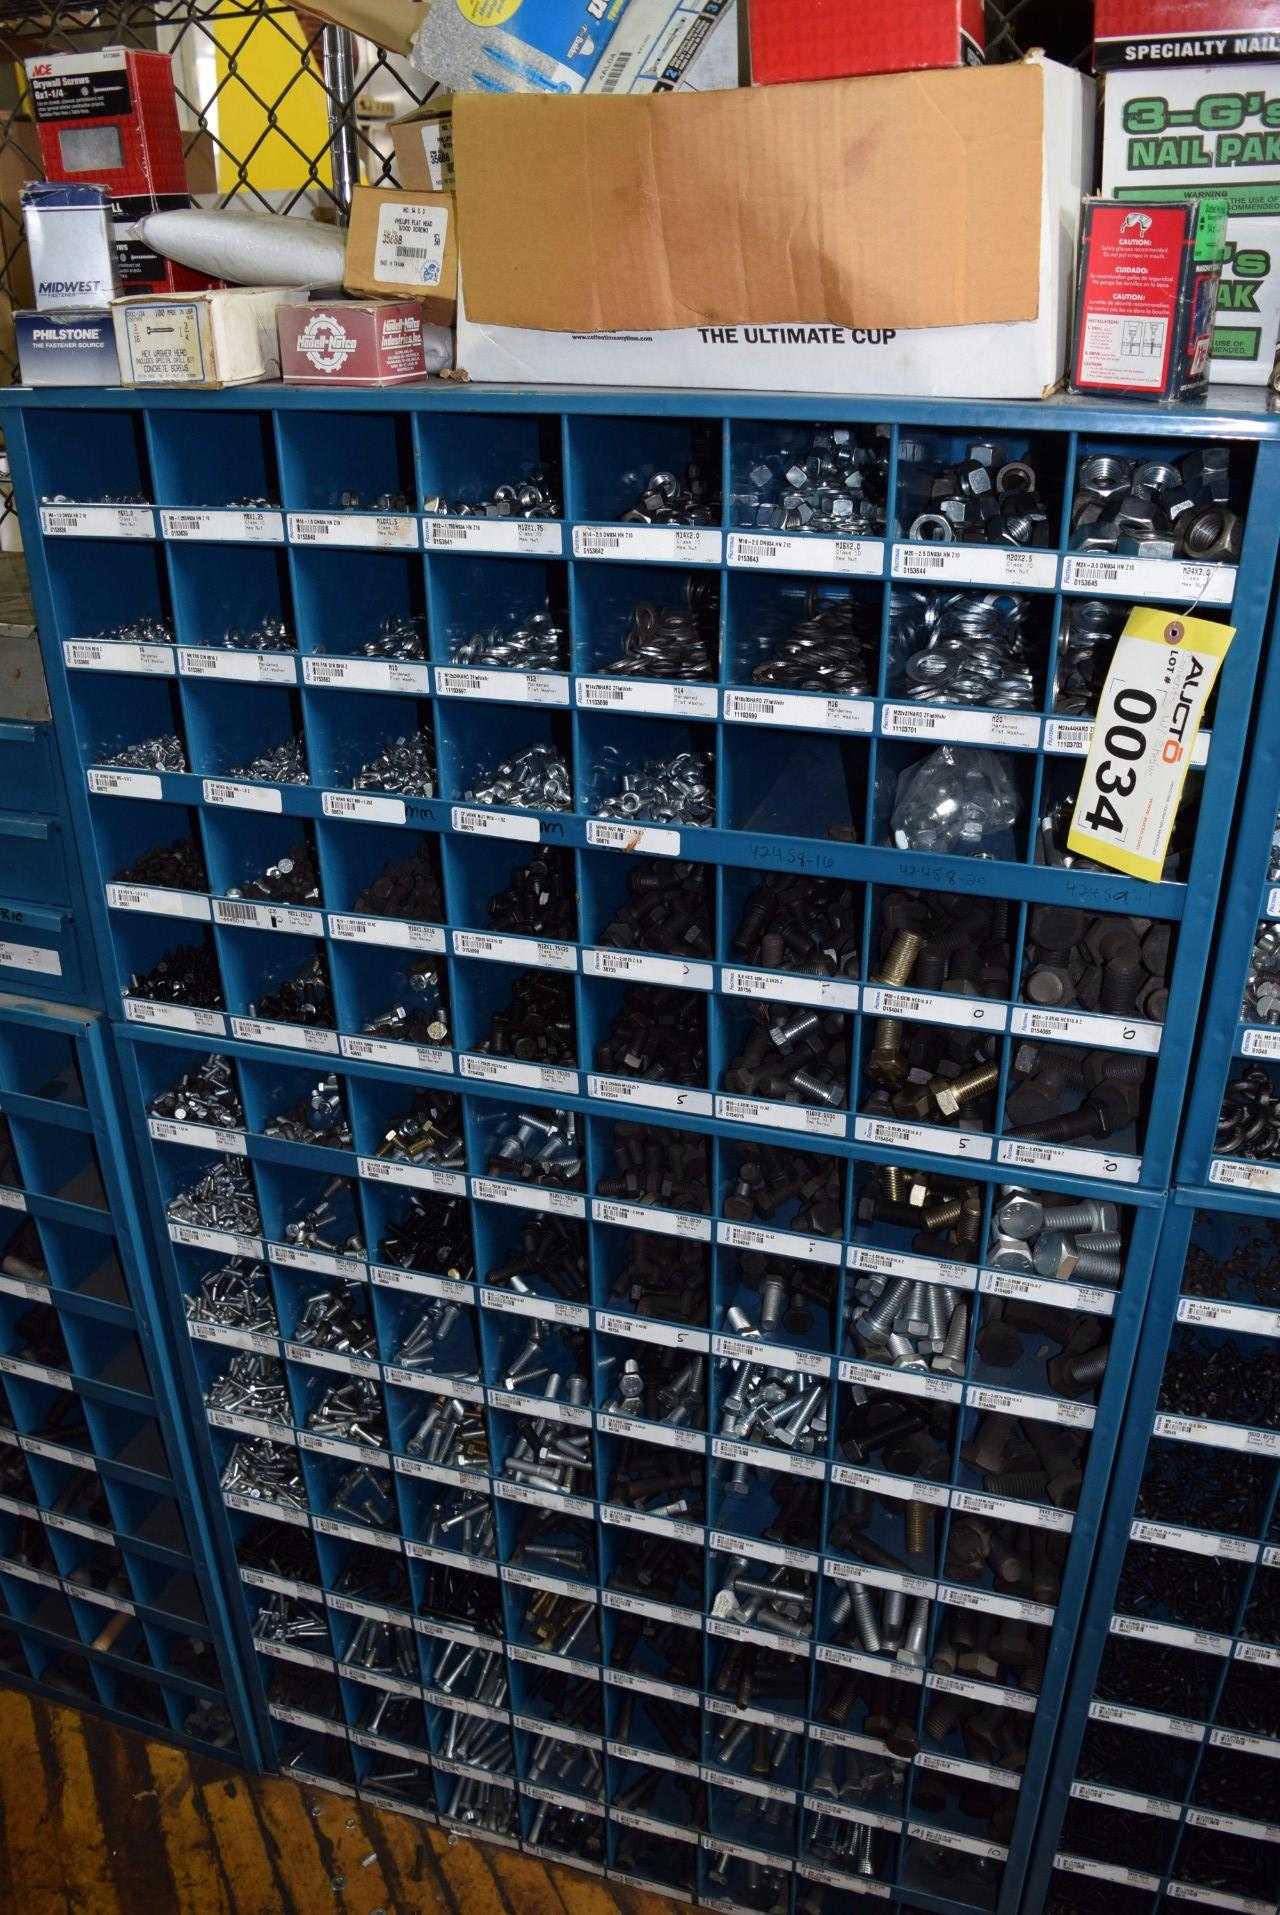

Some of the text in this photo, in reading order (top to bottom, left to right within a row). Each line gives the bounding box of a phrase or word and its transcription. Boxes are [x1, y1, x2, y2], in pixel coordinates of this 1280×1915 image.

[1125, 36, 1280, 61] SPECIALTY NAIL
[32, 64, 52, 76] ACE
[1127, 135, 1213, 171] NAIL
[1184, 190, 1228, 200] WARNING
[39, 280, 101, 293] MIDWEST
[1216, 280, 1265, 312] AK
[33, 329, 100, 340] PHILSTONE
[697, 328, 897, 345] THE ULTIMATE CUP
[1167, 650, 1179, 673] LOT
[1162, 655, 1206, 763] AUCTO
[1085, 688, 1157, 834] 0034
[676, 1094, 688, 1105] 5
